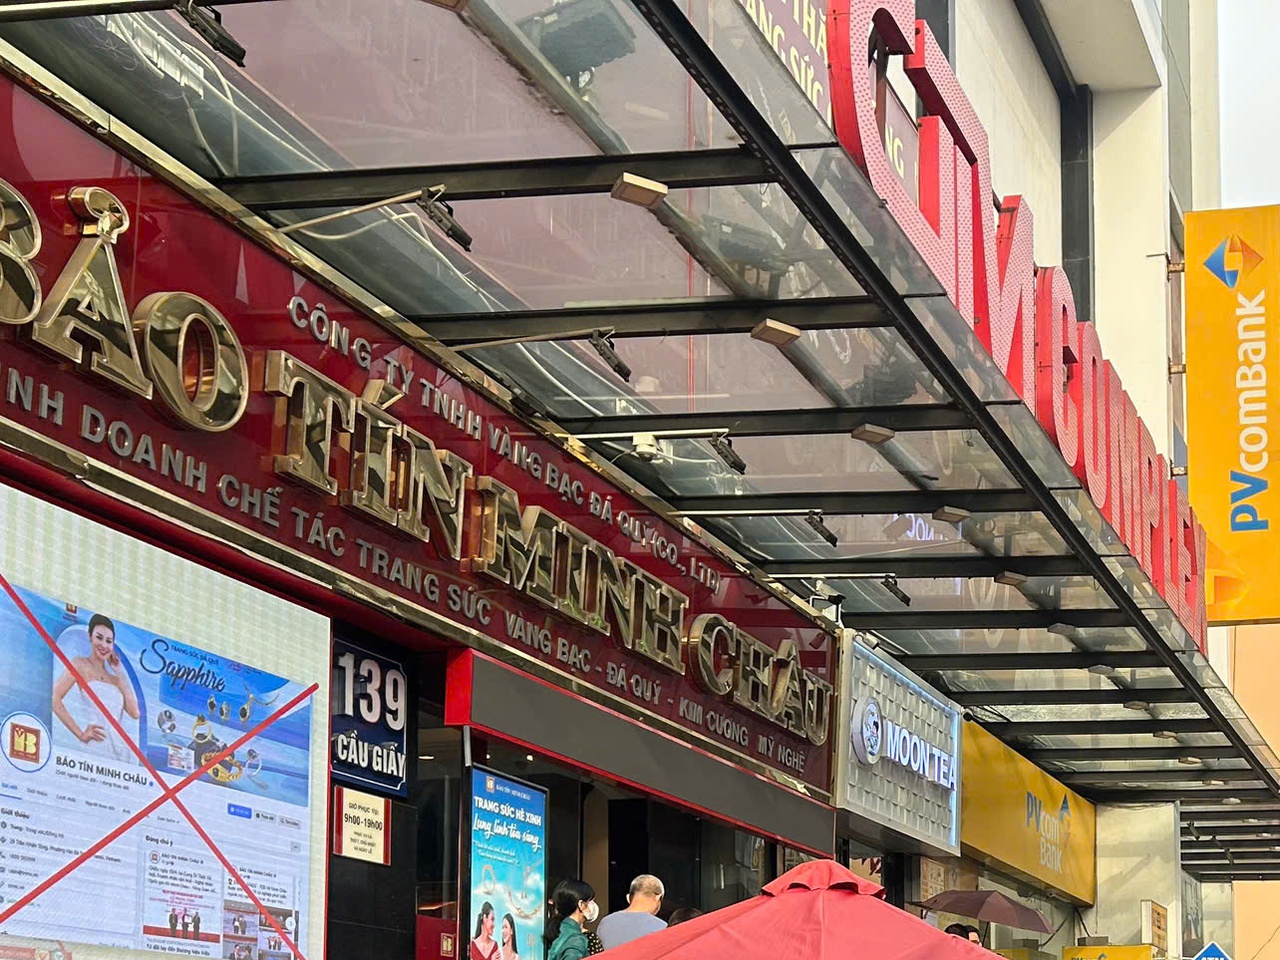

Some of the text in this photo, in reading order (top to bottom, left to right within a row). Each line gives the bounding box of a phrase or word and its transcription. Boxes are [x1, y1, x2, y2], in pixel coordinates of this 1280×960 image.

[288, 296, 371, 368] CÔNG
[382, 356, 414, 395] TY
[419, 378, 482, 440] TNHH
[488, 423, 542, 480] VÀNG
[546, 462, 584, 505] BẠC
[589, 491, 613, 525] ĐÁ
[1230, 289, 1269, 532] PVcomBank
[81, 404, 207, 494] DOANH
[218, 473, 282, 530] CHẾ
[291, 506, 346, 557] TÁC
[356, 538, 440, 603] TRANG
[447, 584, 492, 626] SỨC
[505, 610, 552, 654] VÀNG
[557, 637, 591, 674] BẠC
[606, 662, 628, 691] ĐÁ
[630, 674, 661, 705] QUÝ
[679, 697, 703, 725] KIM
[265, 349, 473, 560] TÍN
[476, 475, 689, 676] MINH
[690, 613, 834, 747] CHÂU
[140, 638, 225, 692] Sapphire
[338, 652, 406, 731] 139
[56, 755, 76, 769] BẢO
[78, 760, 94, 774] TÍN
[95, 766, 121, 779] MINH
[123, 772, 147, 786] CHÂU
[337, 730, 406, 777] CẦU GIẤY
[886, 720, 957, 793] MOON TEA
[474, 796, 541, 826] TRANG SỨC HÈ XINH
[1040, 835, 1062, 874] Bank
